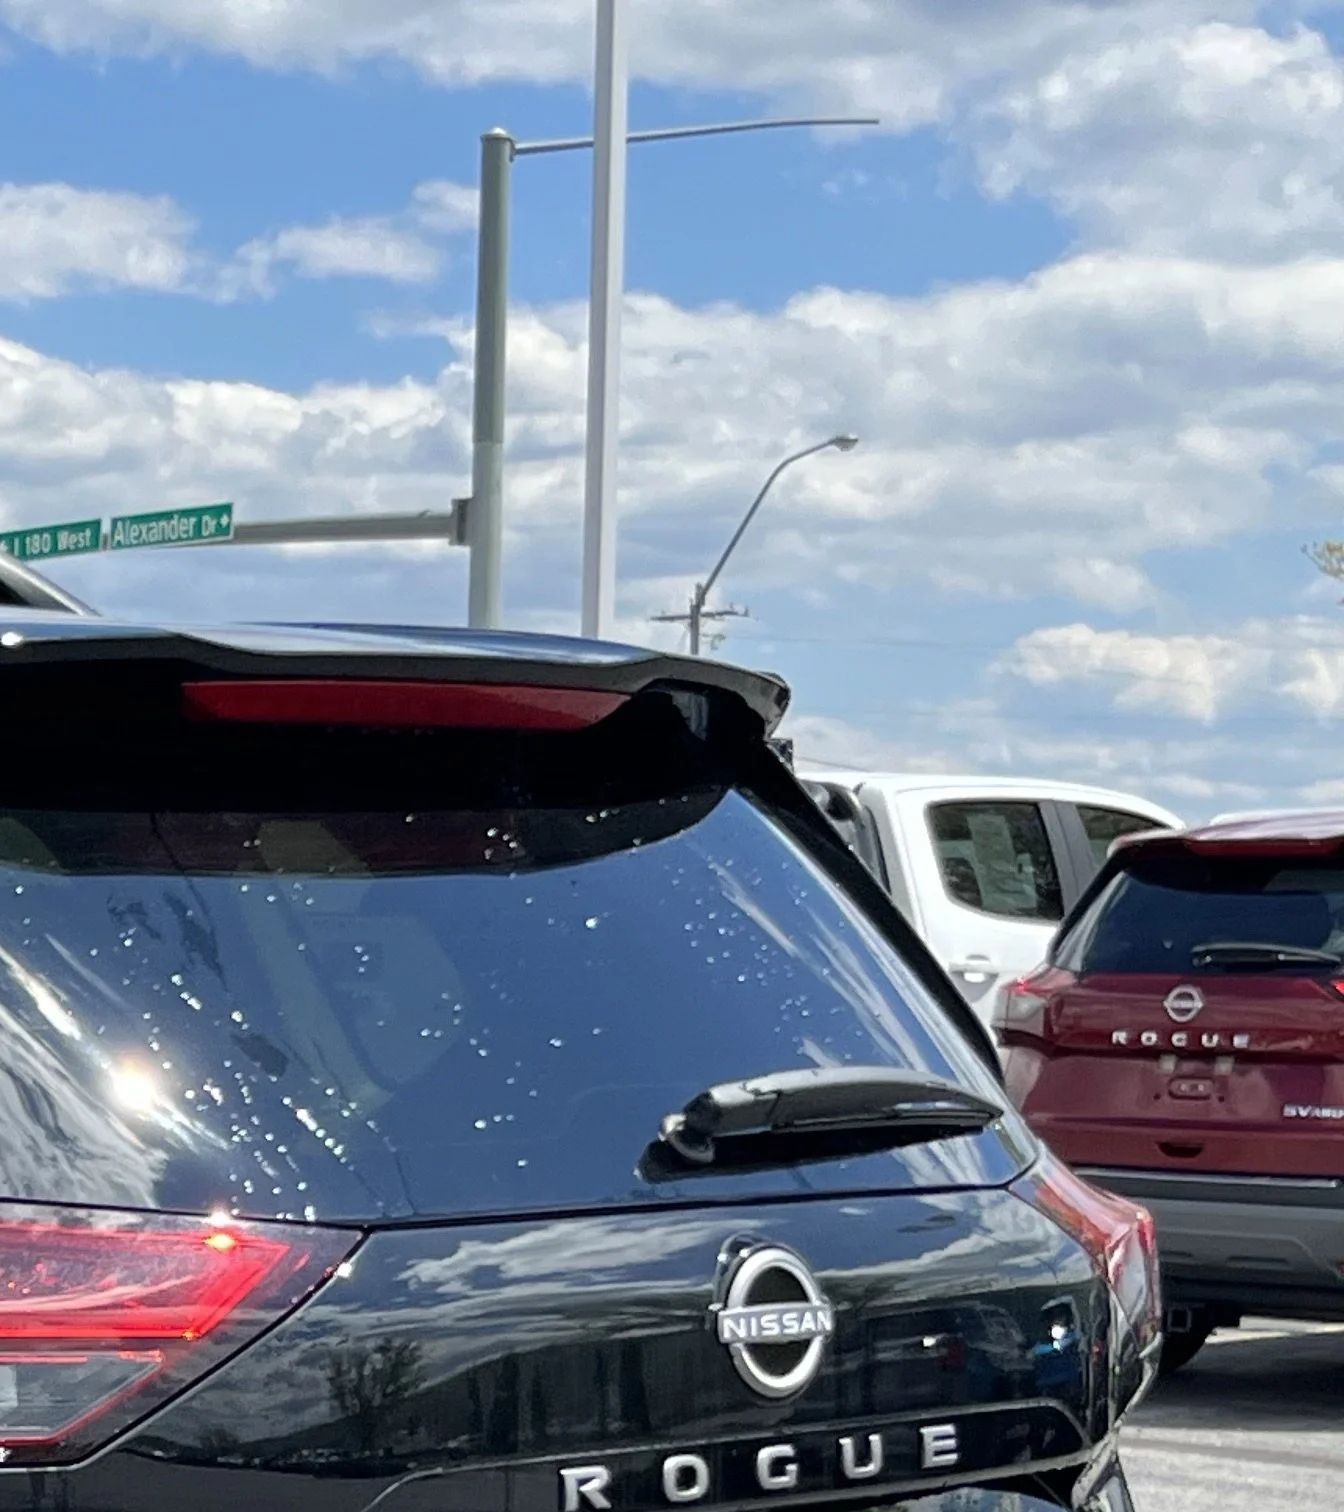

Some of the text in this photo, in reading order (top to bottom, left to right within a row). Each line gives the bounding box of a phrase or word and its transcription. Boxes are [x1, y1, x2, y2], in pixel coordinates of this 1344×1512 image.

[25, 533, 51, 556] 180
[57, 527, 92, 551] West
[112, 513, 218, 547] Alexander Dr
[1111, 1030, 1250, 1049] ROGUE
[722, 1310, 832, 1339] NISSAN
